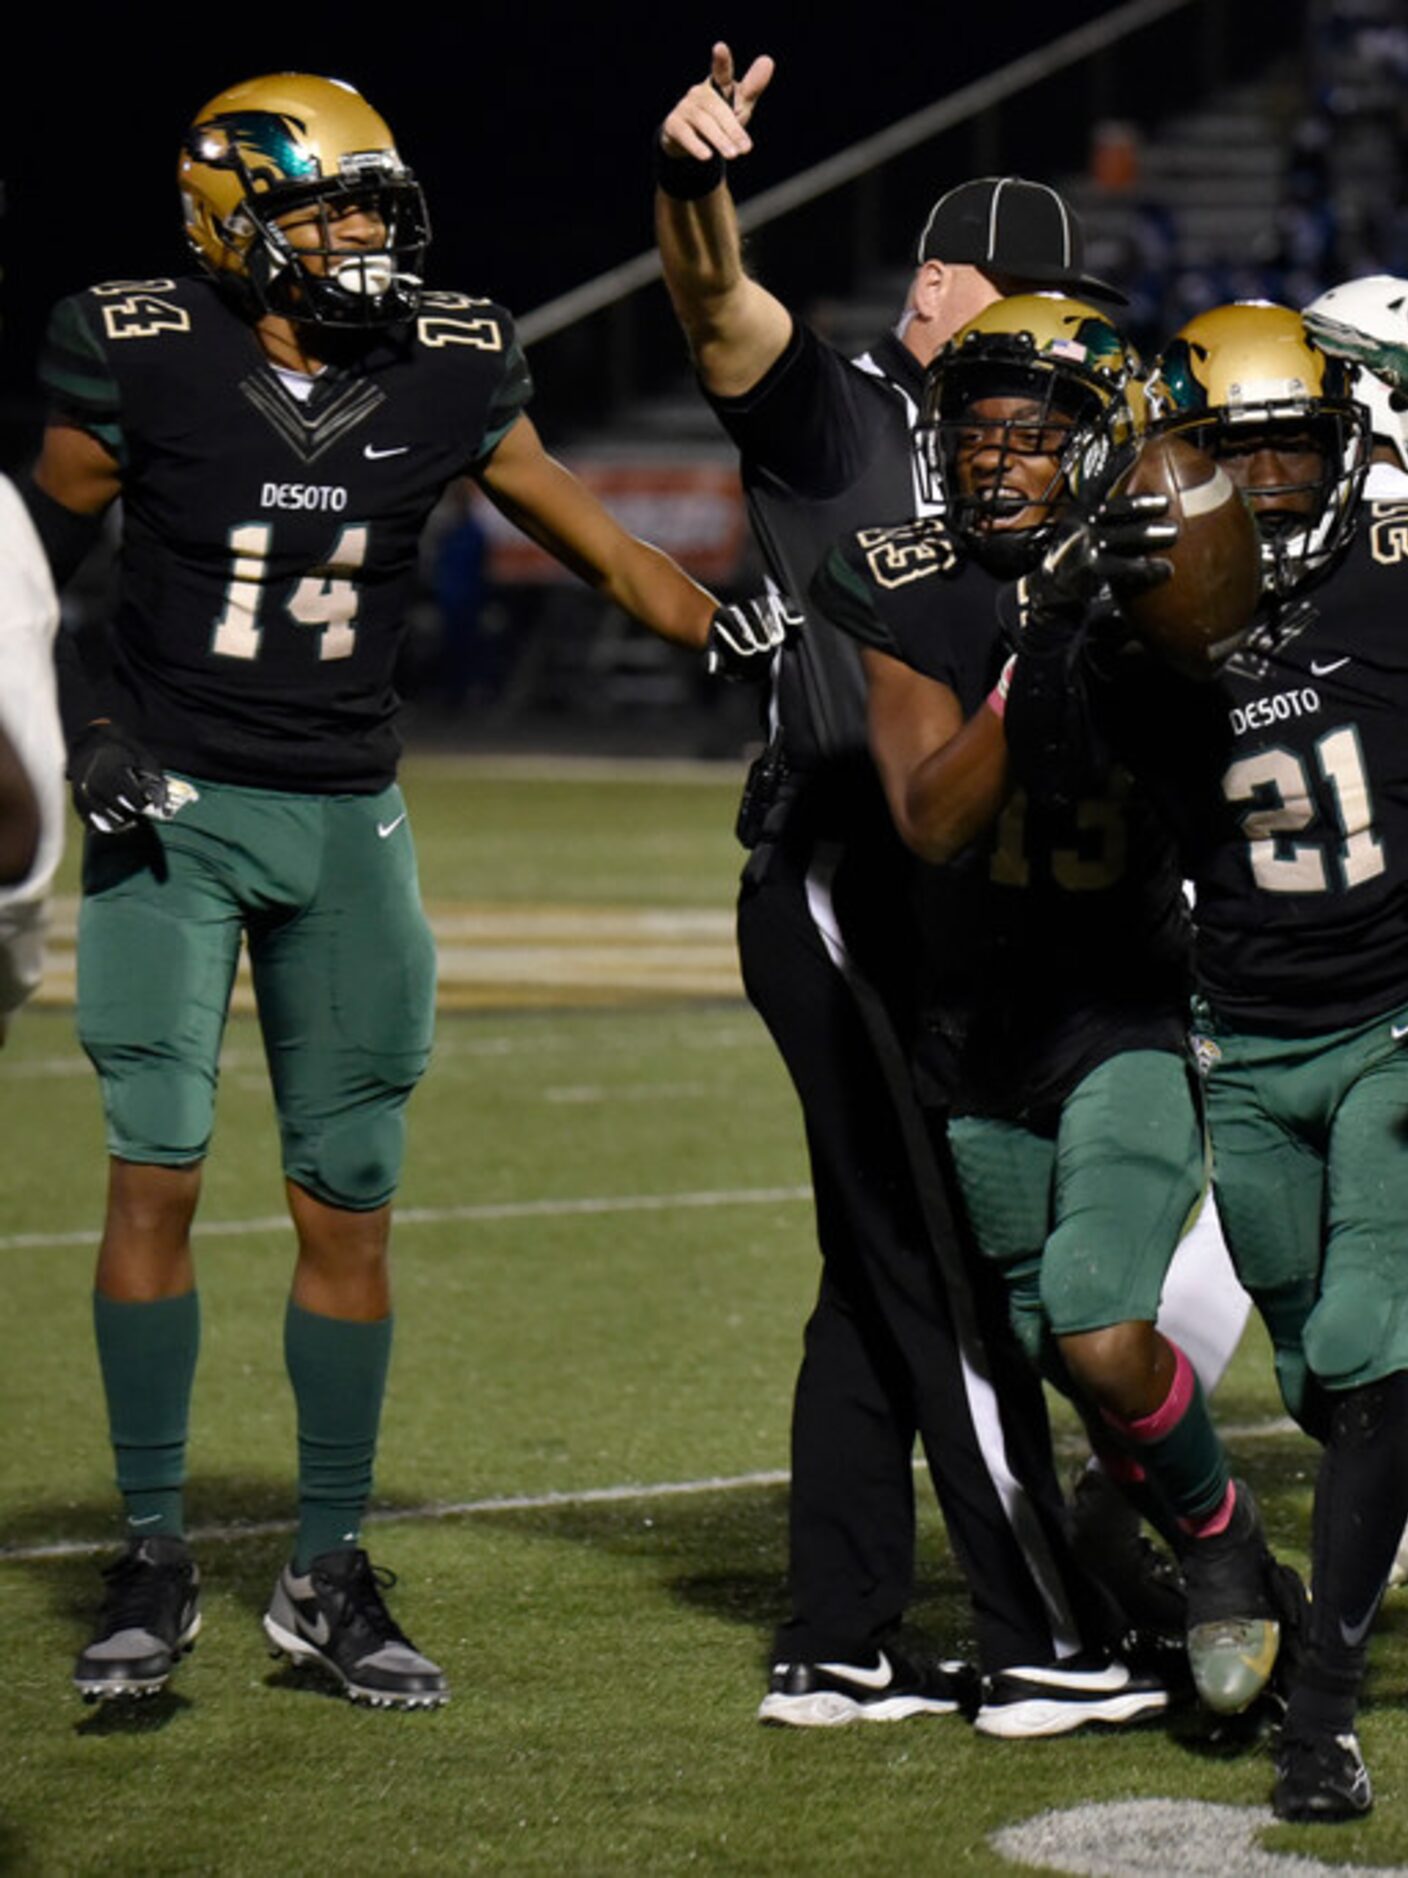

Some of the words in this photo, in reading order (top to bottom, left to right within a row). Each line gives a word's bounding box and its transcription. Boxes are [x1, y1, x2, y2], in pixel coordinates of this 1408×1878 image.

[260, 482, 348, 512] DESOTO
[208, 521, 370, 662] 14
[1228, 687, 1321, 736] DESOTO
[1220, 722, 1388, 893] 21
